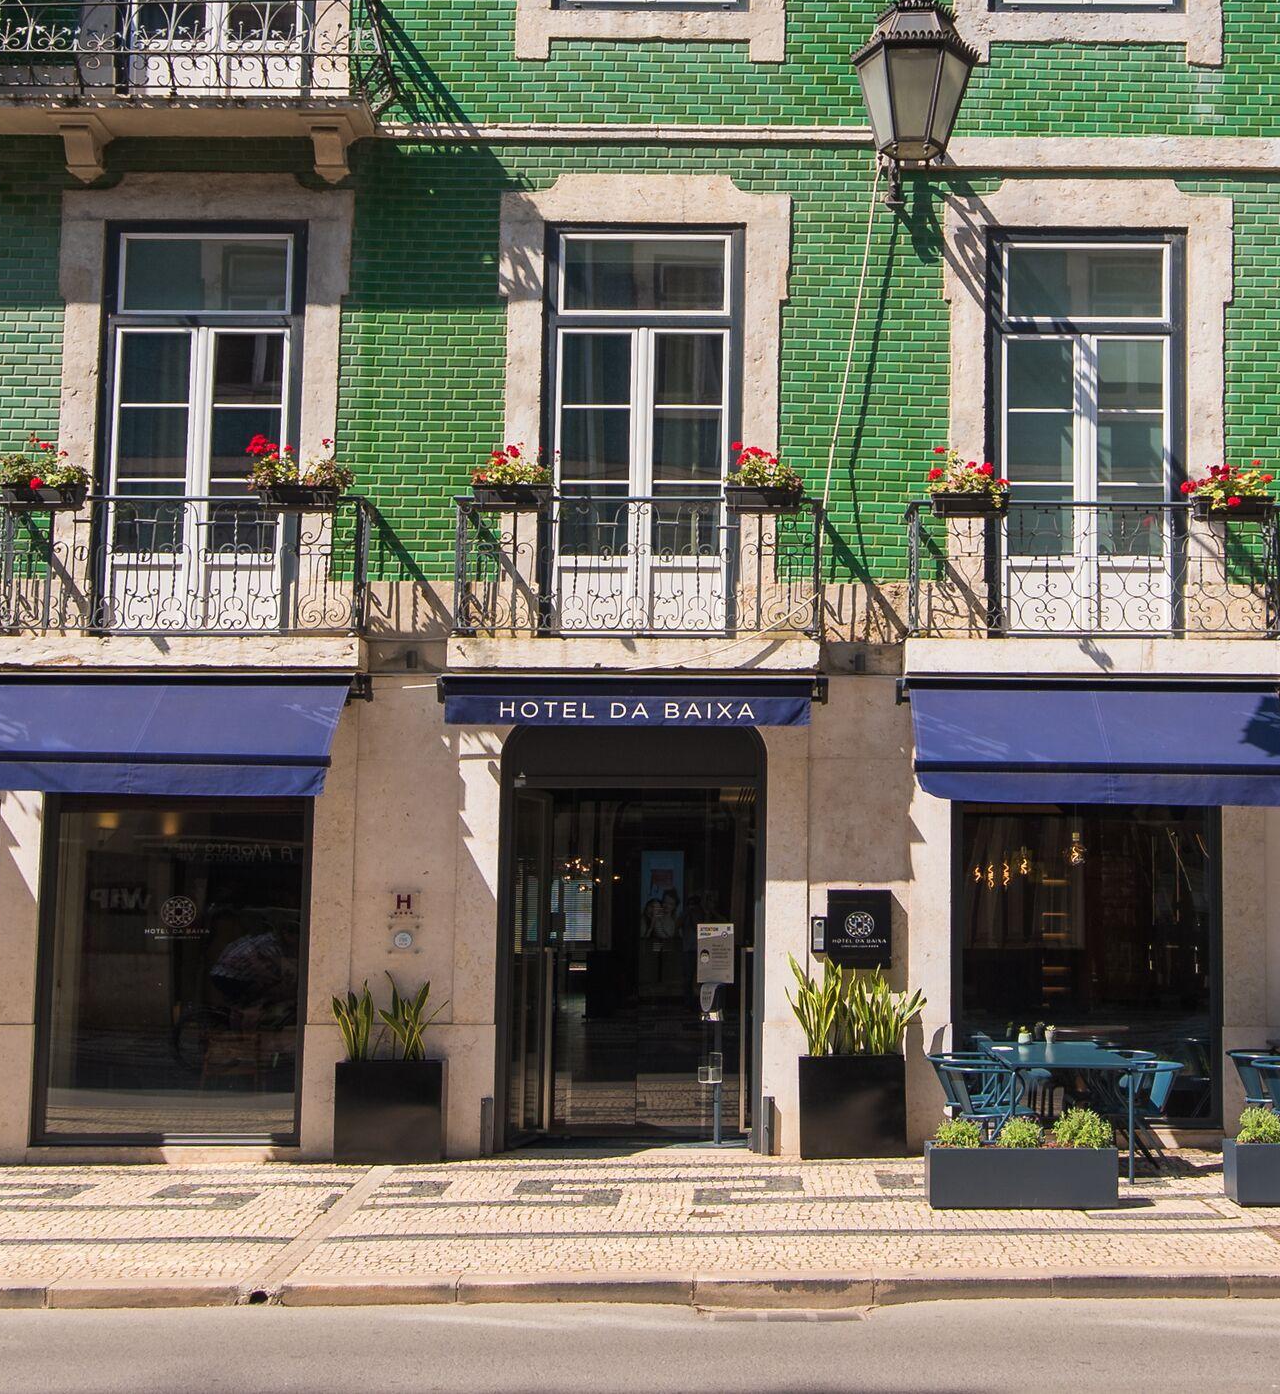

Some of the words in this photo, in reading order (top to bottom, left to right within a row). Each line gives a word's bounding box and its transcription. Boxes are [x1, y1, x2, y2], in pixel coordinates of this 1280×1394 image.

[499, 701, 595, 719] HOTEL
[610, 702, 649, 719] DA
[664, 702, 755, 720] BAIXA
[397, 894, 411, 909] H
